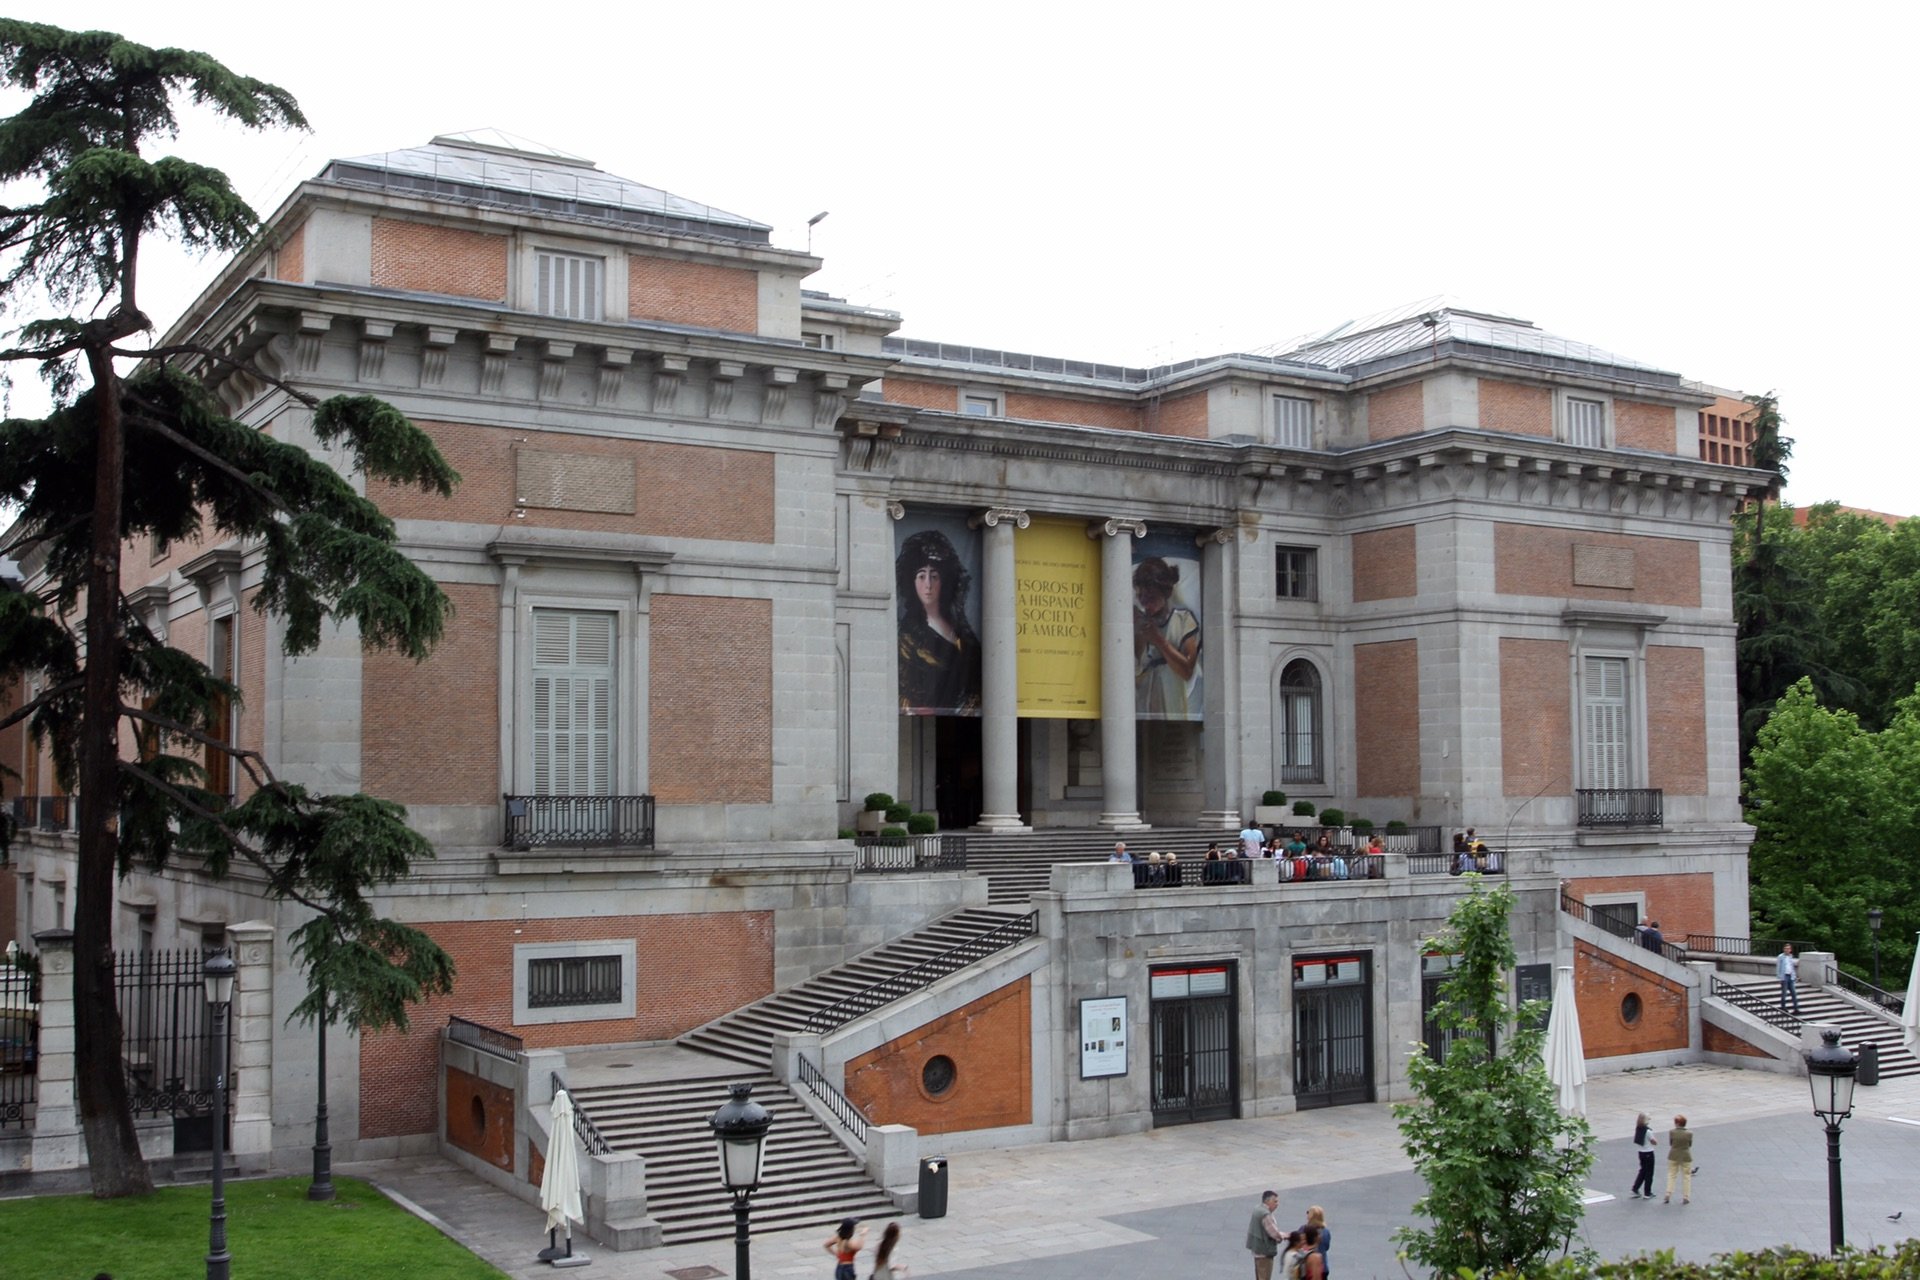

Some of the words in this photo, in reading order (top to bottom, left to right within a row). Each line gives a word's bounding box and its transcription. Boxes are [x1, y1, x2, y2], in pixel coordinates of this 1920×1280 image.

[1016, 579, 1068, 594] ESOROS
[1072, 583, 1085, 595] DE
[1030, 594, 1085, 610] HISPANIC
[1022, 608, 1075, 623] SOCIETY
[1032, 623, 1087, 639] AMERICA
